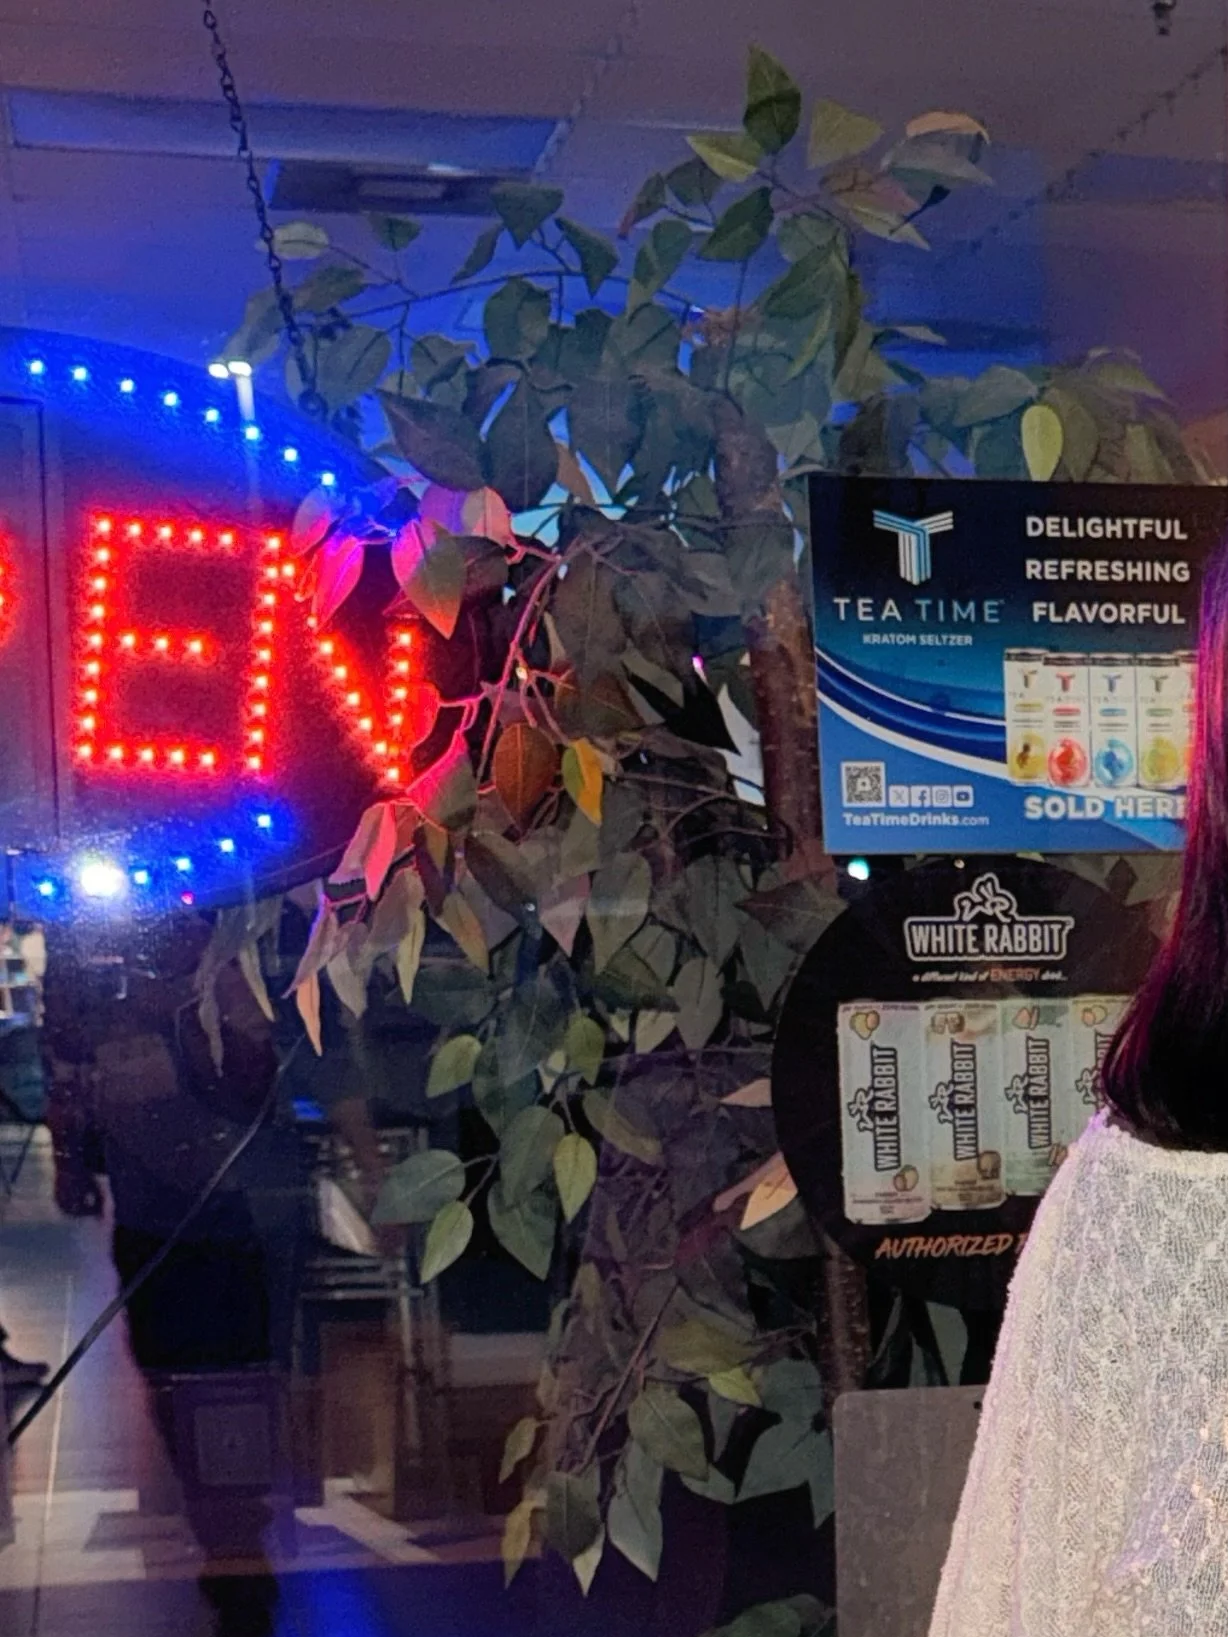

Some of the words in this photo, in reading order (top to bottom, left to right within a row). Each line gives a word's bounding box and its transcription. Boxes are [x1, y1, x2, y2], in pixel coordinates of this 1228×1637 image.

[1025, 516, 1188, 540] DELIGHTFUL
[1025, 560, 1190, 582] REFRESHING
[833, 597, 902, 622] TEA
[914, 599, 1000, 623] TIME
[1032, 602, 1186, 625] FLAVORFUL
[0, 508, 424, 795] EN
[862, 633, 917, 645] KRATOM
[919, 634, 973, 646] SELTZER
[843, 812, 991, 827] TeaTimeDrinks.com
[1024, 796, 1105, 820] SOLD
[911, 924, 980, 954] WHITE
[984, 923, 1063, 953] RABBIT
[990, 968, 1041, 982] ENERGY
[873, 1047, 897, 1112] RABBIT
[952, 1042, 976, 1107] RABBIT
[1027, 1038, 1049, 1099] RABBIT
[955, 1107, 977, 1160] WHITE
[1029, 1098, 1050, 1148] WHITE
[876, 1114, 899, 1170] WHITE
[875, 1234, 1013, 1260] AUTHORIZED
